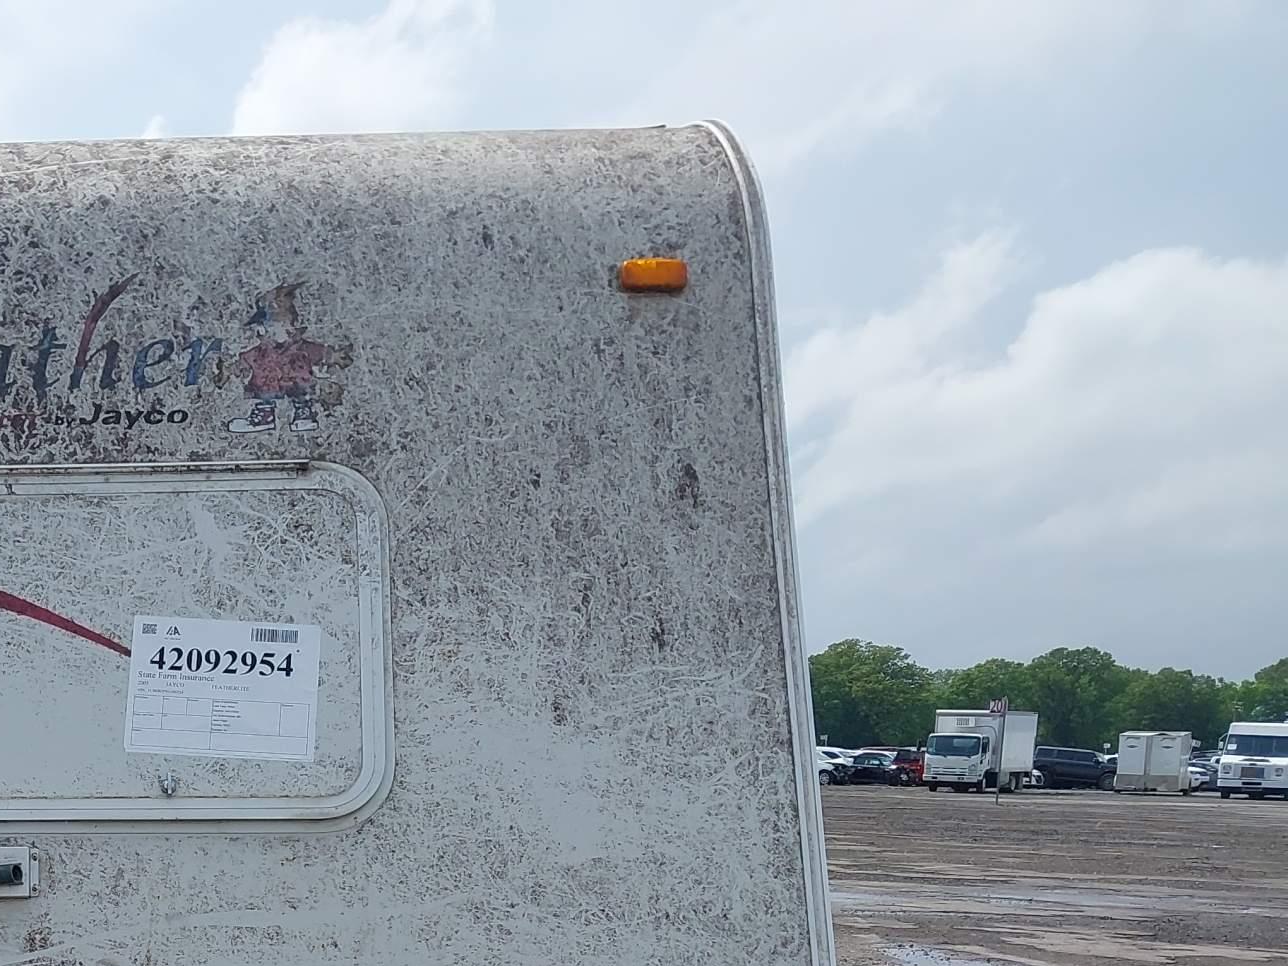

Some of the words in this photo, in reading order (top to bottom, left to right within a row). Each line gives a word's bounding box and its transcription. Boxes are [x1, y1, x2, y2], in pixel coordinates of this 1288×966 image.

[79, 402, 189, 429] Jayco
[149, 646, 294, 678] 42092954
[137, 671, 156, 679] State
[158, 672, 178, 680] Farm
[179, 672, 216, 682] Insurance
